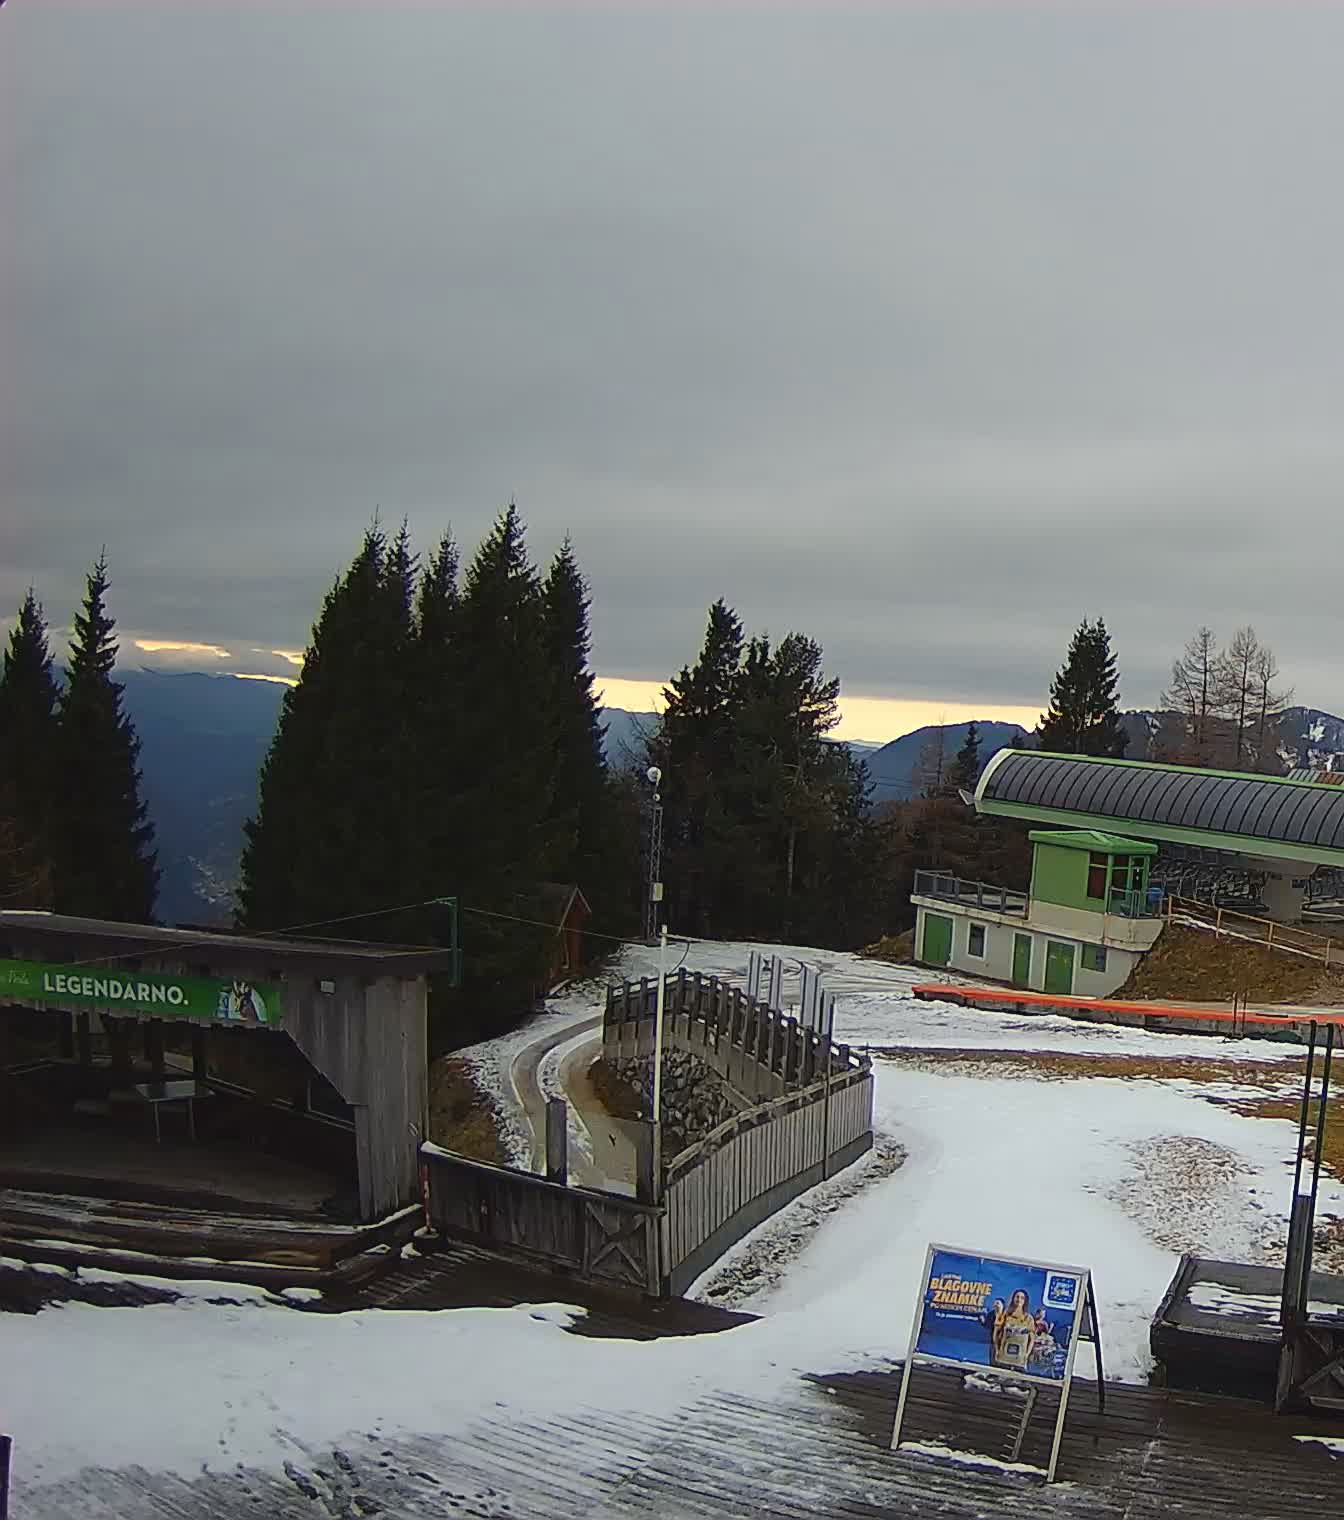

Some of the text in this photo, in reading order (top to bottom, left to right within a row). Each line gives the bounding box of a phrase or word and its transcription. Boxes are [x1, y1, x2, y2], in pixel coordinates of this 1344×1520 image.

[44, 973, 189, 1005] LEGENDARNO.
[929, 1277, 993, 1295] BLAGOVNE
[932, 1290, 985, 1307] ZNAMKE
